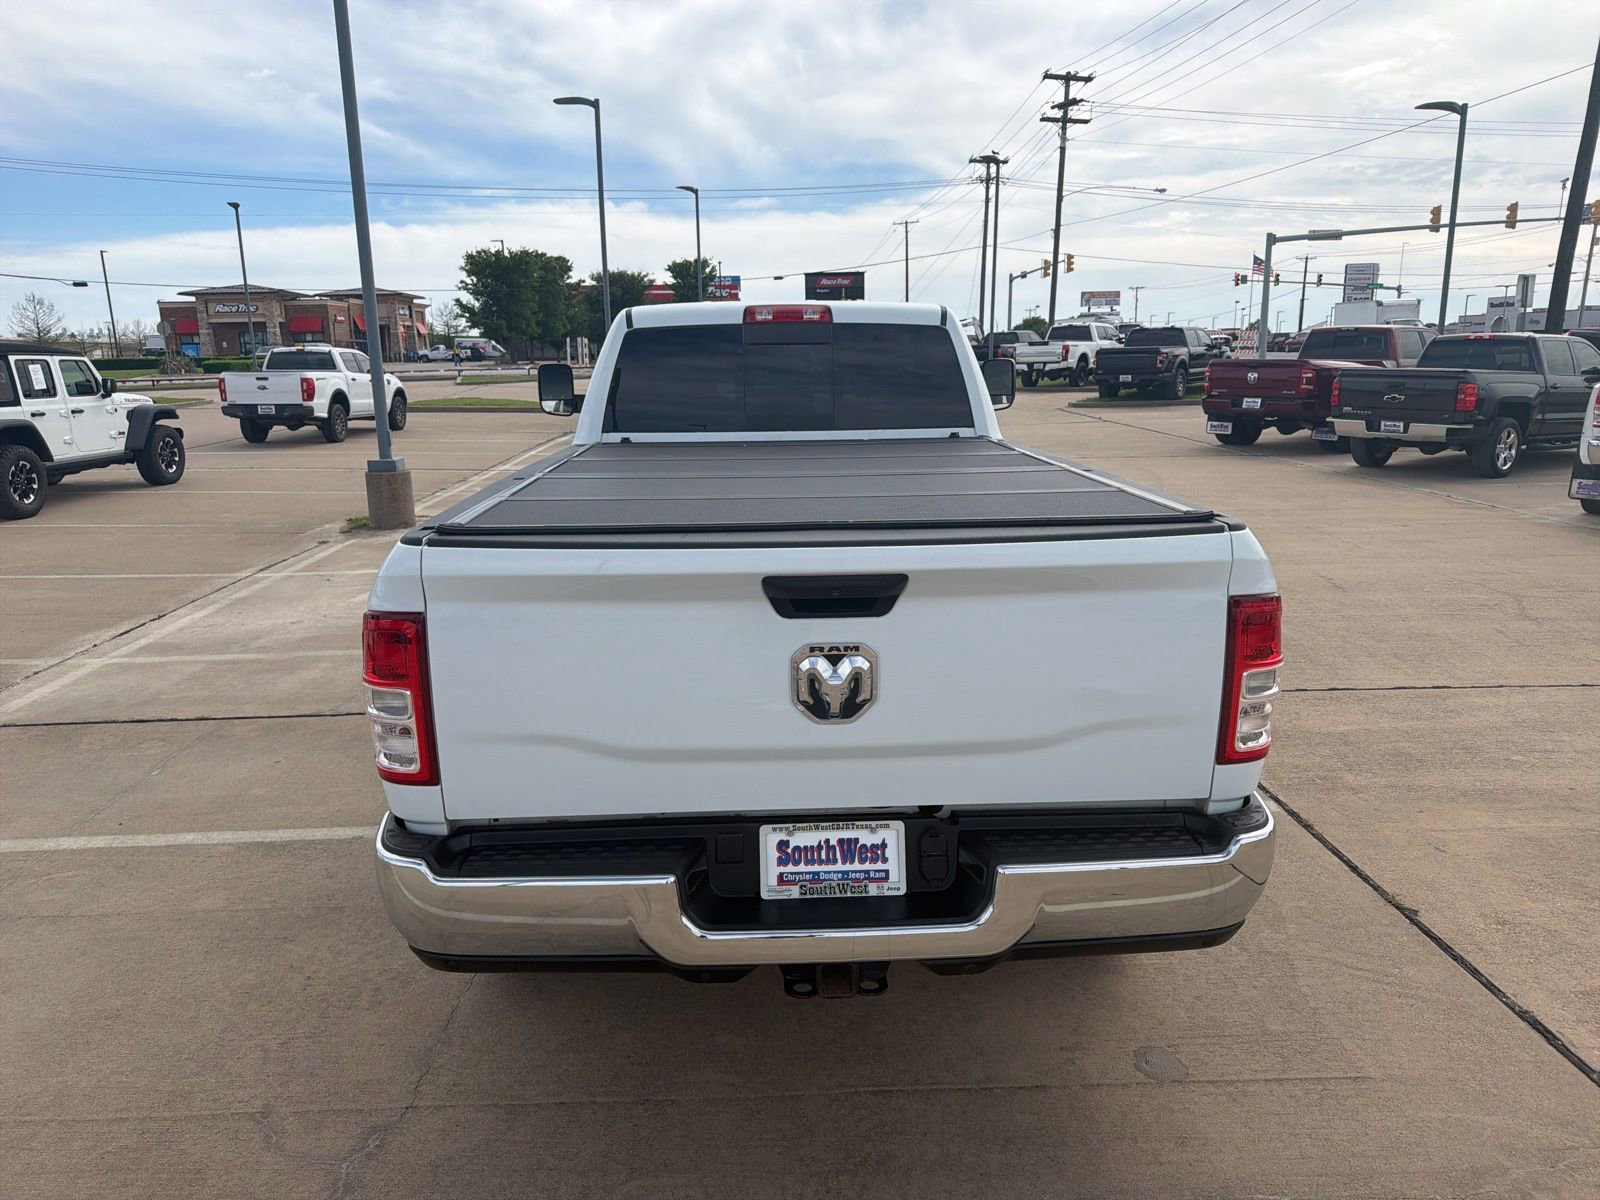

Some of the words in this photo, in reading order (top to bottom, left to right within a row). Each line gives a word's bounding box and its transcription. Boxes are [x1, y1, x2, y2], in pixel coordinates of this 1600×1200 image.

[809, 645, 860, 653] RAM
[776, 837, 889, 868] SouthWest
[783, 873, 813, 882] Chrysler
[819, 871, 843, 881] Dodge
[848, 871, 865, 880] Jeep
[869, 870, 886, 879] Ram
[799, 882, 870, 897] SouthWest
